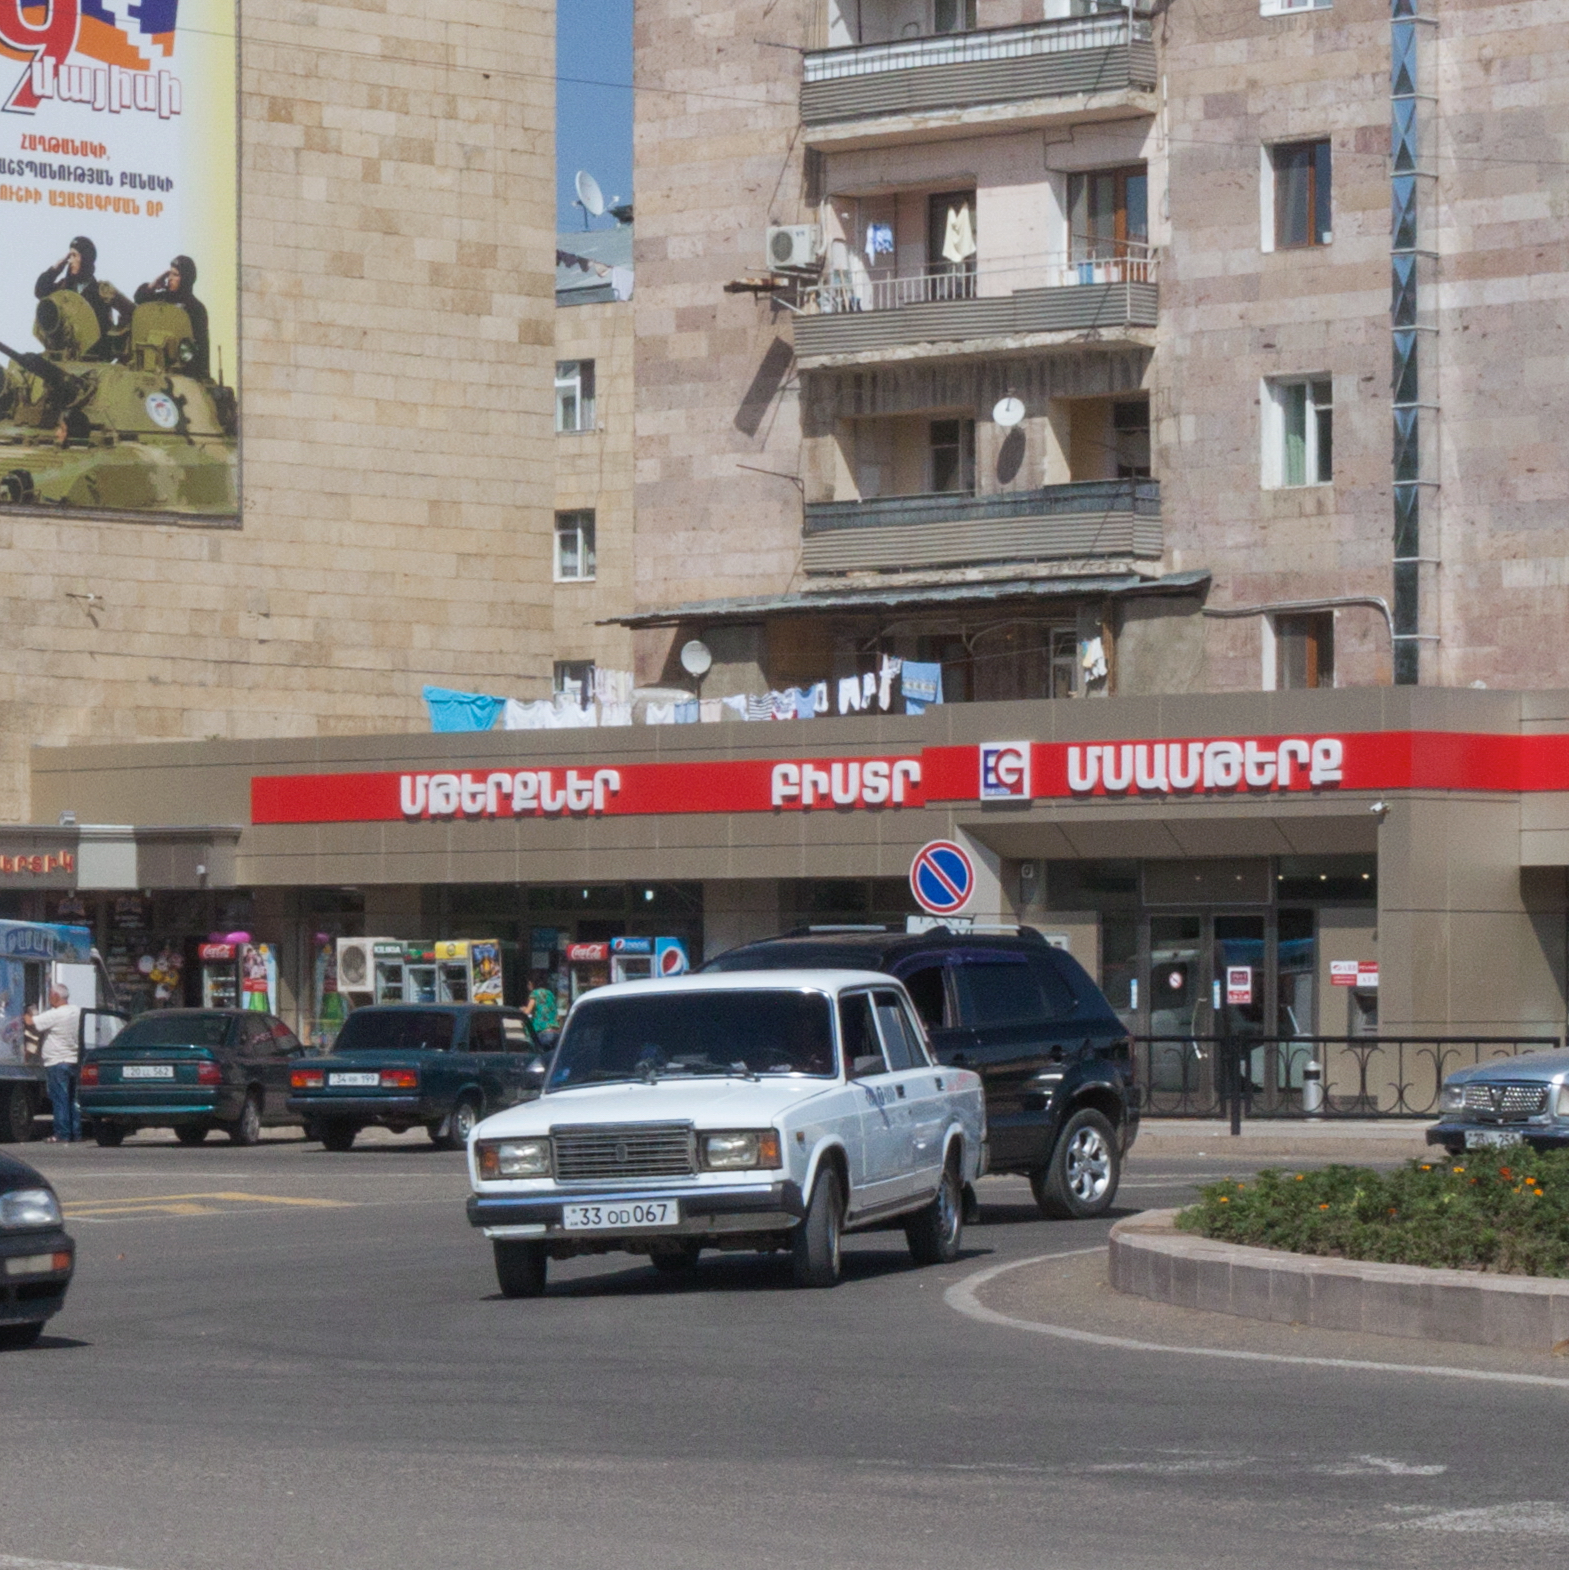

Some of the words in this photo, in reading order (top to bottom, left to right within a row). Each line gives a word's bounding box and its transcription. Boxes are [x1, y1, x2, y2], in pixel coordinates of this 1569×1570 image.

[771, 760, 921, 806] ԲԻՍՏՐ
[983, 747, 1024, 795] EG
[1067, 738, 1343, 792] ՄՍԱՄԹԵՐՔ
[399, 769, 622, 816] ՄԹԵՐՔՆԵՐ
[579, 1207, 602, 1226] 33
[607, 1210, 630, 1224] OD
[633, 1204, 667, 1223] 067
